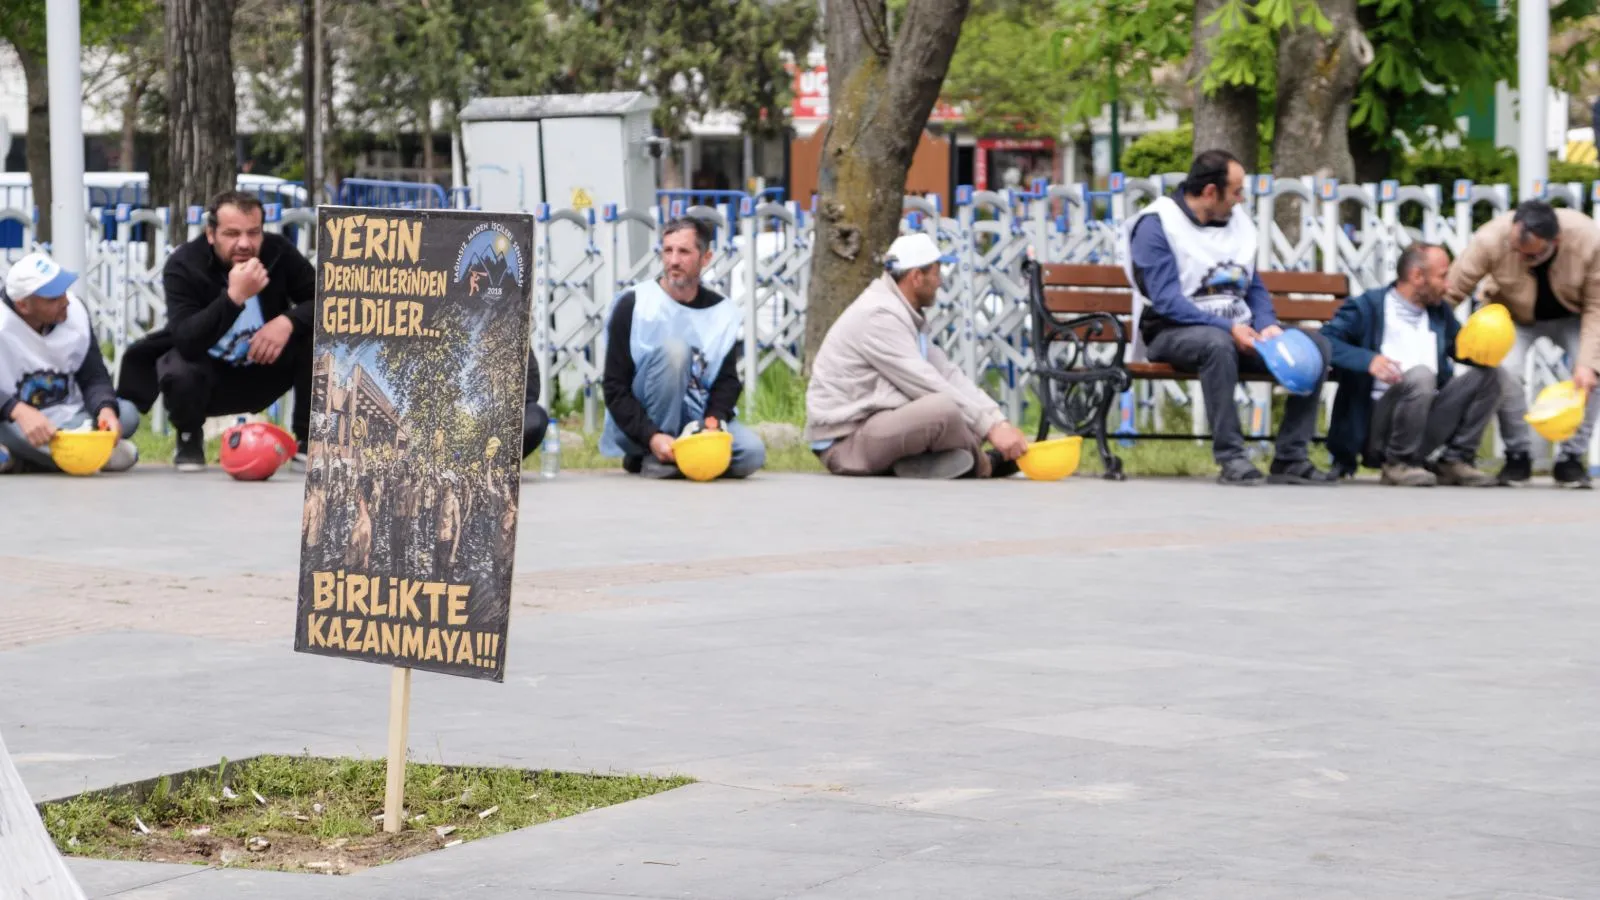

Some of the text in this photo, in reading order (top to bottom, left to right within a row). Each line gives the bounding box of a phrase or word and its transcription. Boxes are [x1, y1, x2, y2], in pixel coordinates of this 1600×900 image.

[326, 214, 423, 264] YERİN
[467, 223, 489, 241] MADEN
[323, 261, 447, 298] DERİNLİKLERİNDEN
[487, 287, 503, 295] 2018
[322, 296, 441, 338] GELDİLER...
[311, 569, 471, 625] BİRLİKTE
[308, 612, 499, 669] KAZANMAYA!!!
